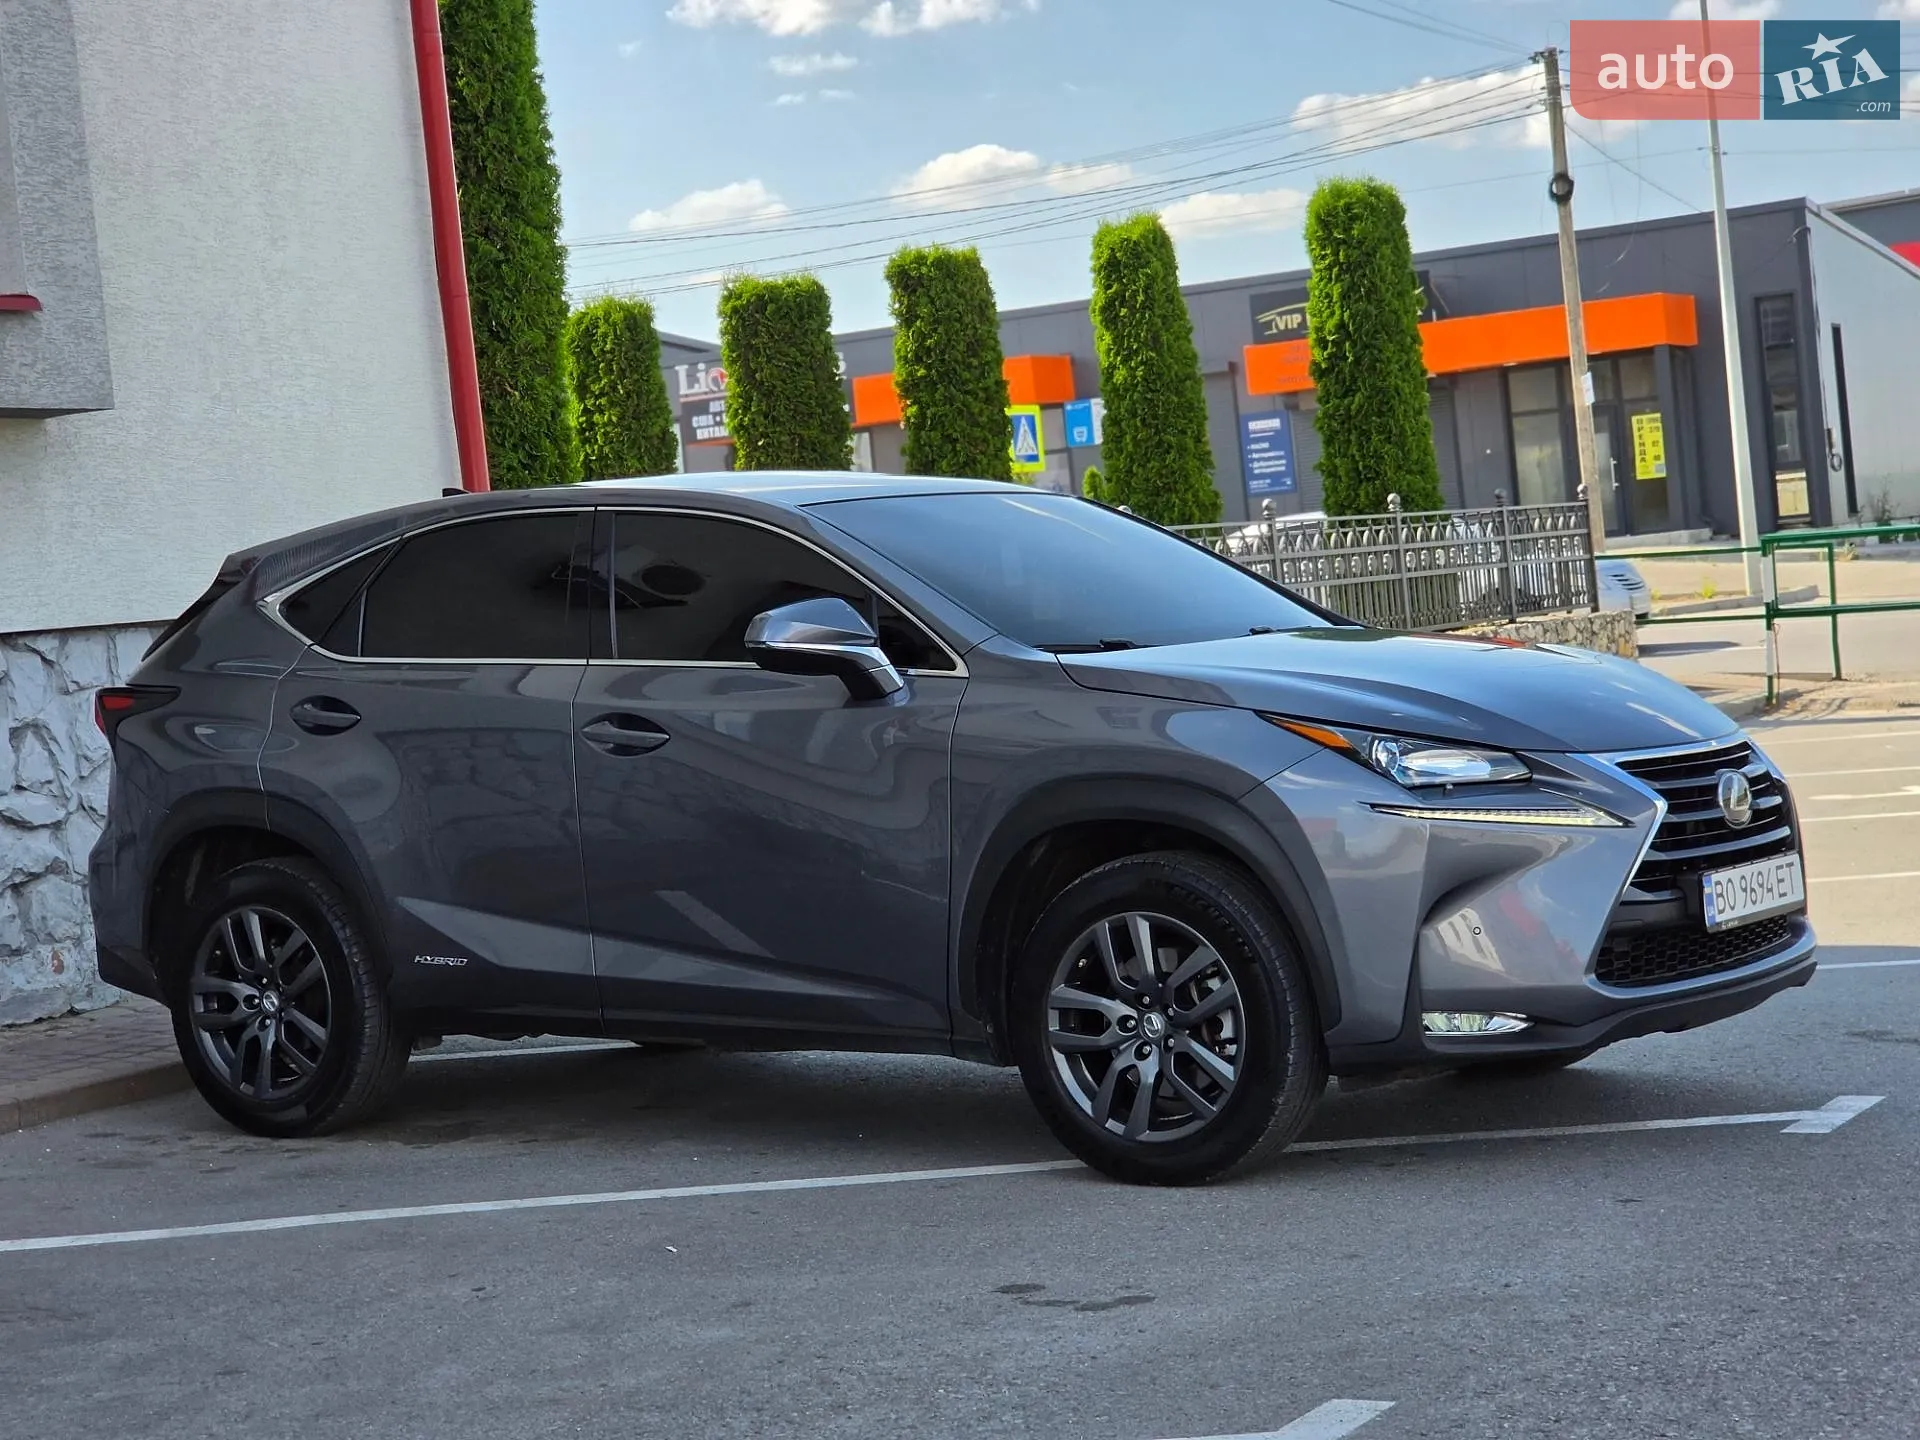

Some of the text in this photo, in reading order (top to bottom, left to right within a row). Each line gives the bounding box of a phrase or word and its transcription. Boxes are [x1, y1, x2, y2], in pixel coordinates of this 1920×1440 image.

[1275, 313, 1302, 330] VIP
[1714, 861, 1795, 915] BO 9694 ET
[414, 955, 468, 966] HYBRID
